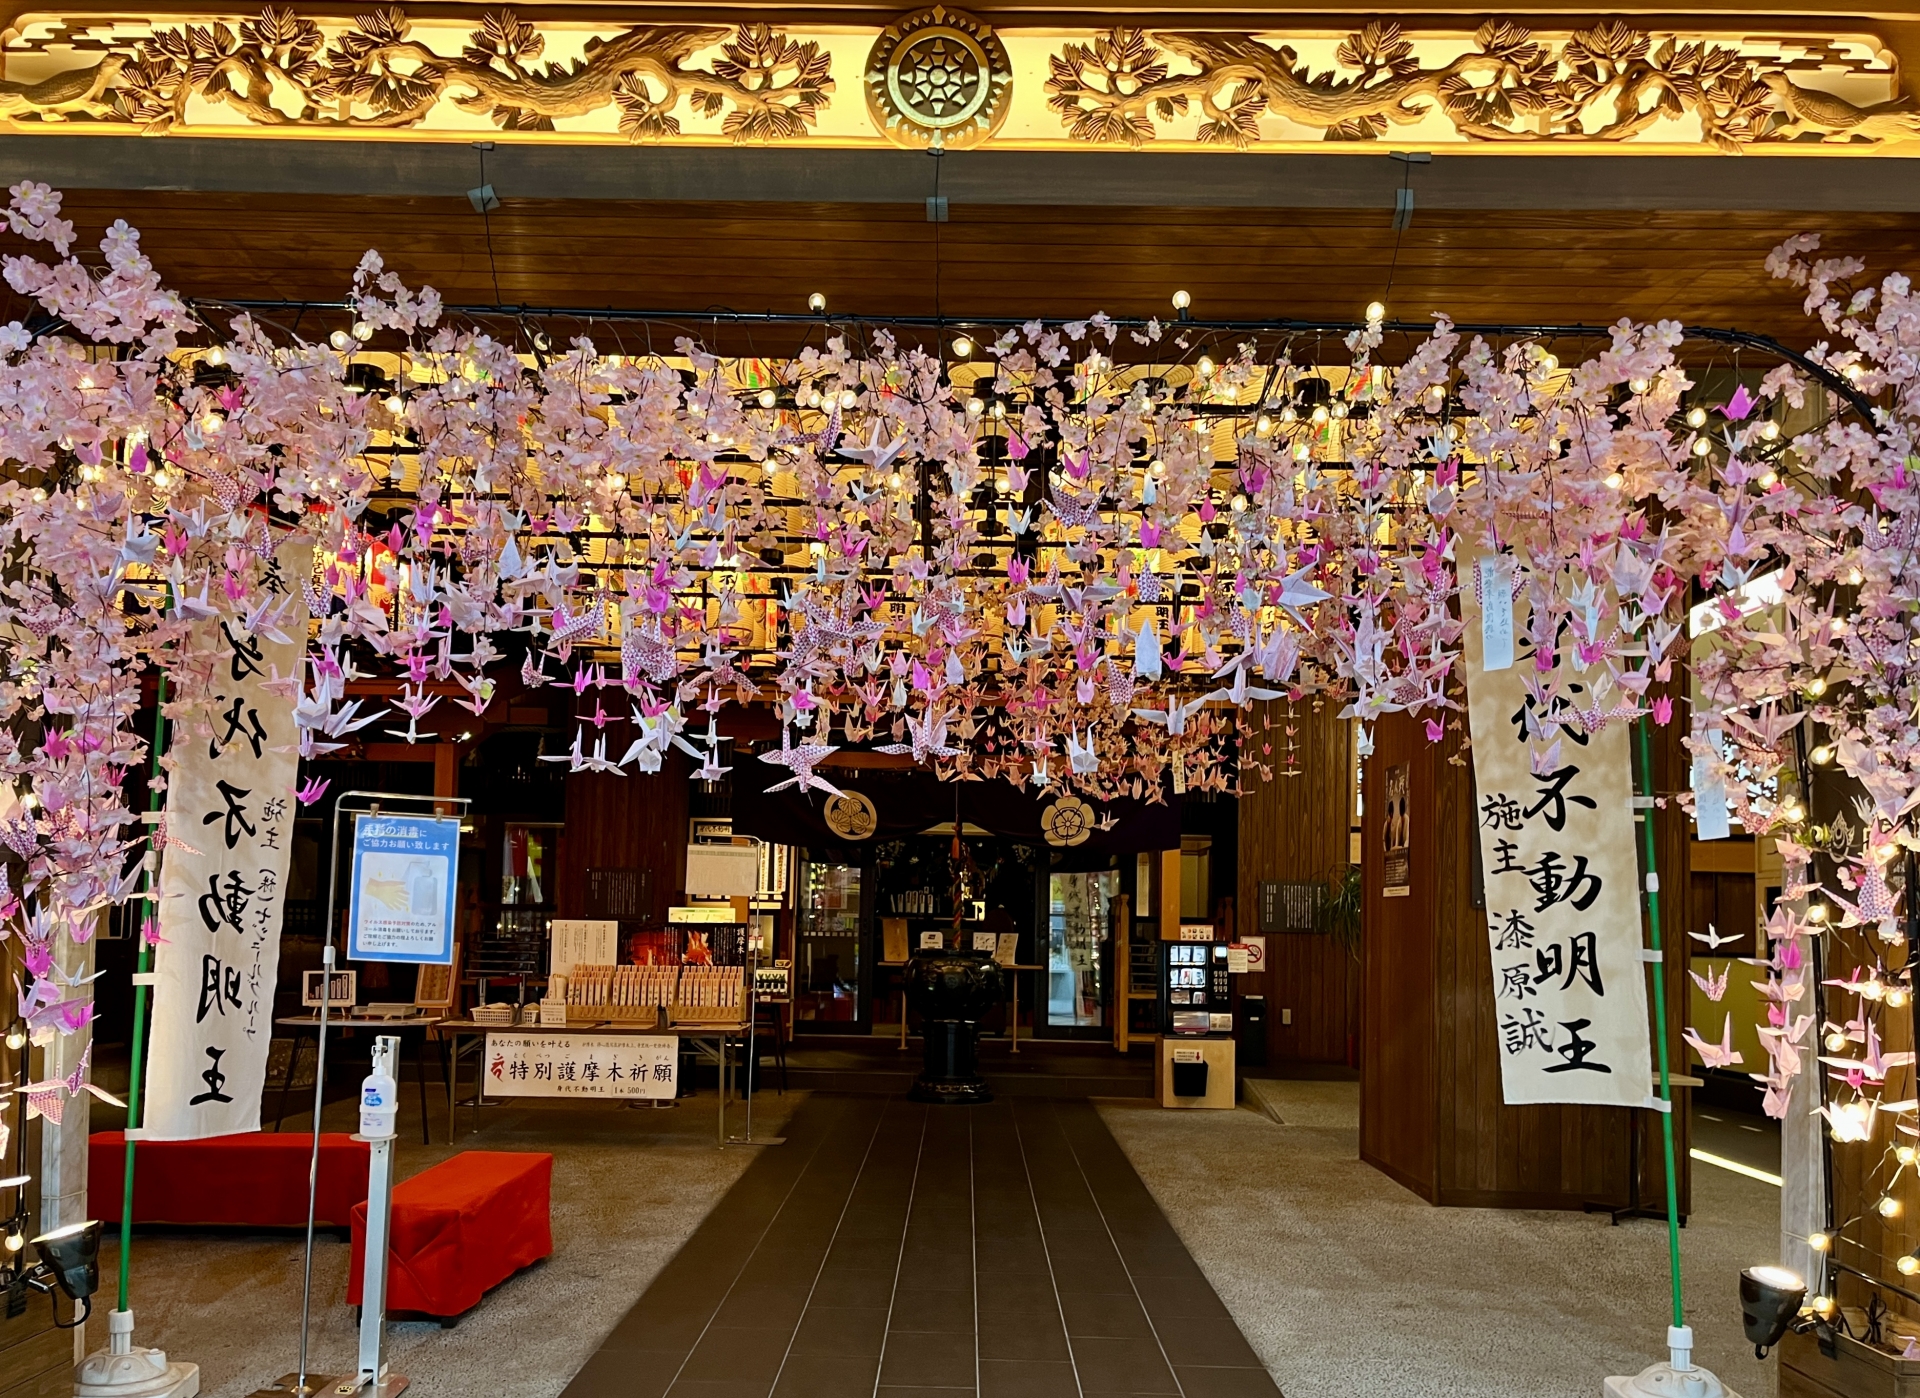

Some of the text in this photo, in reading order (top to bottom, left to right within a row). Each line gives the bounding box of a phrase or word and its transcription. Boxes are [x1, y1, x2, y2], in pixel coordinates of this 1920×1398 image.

[362, 838, 450, 851] ご協力お願い致します
[1480, 793, 1556, 1056] 施主 漆原誠
[490, 1039, 571, 1048] あなたの願いを叶える
[509, 1061, 673, 1083] 特別護摩木祈願
[556, 1085, 606, 1093] 身代不動明王
